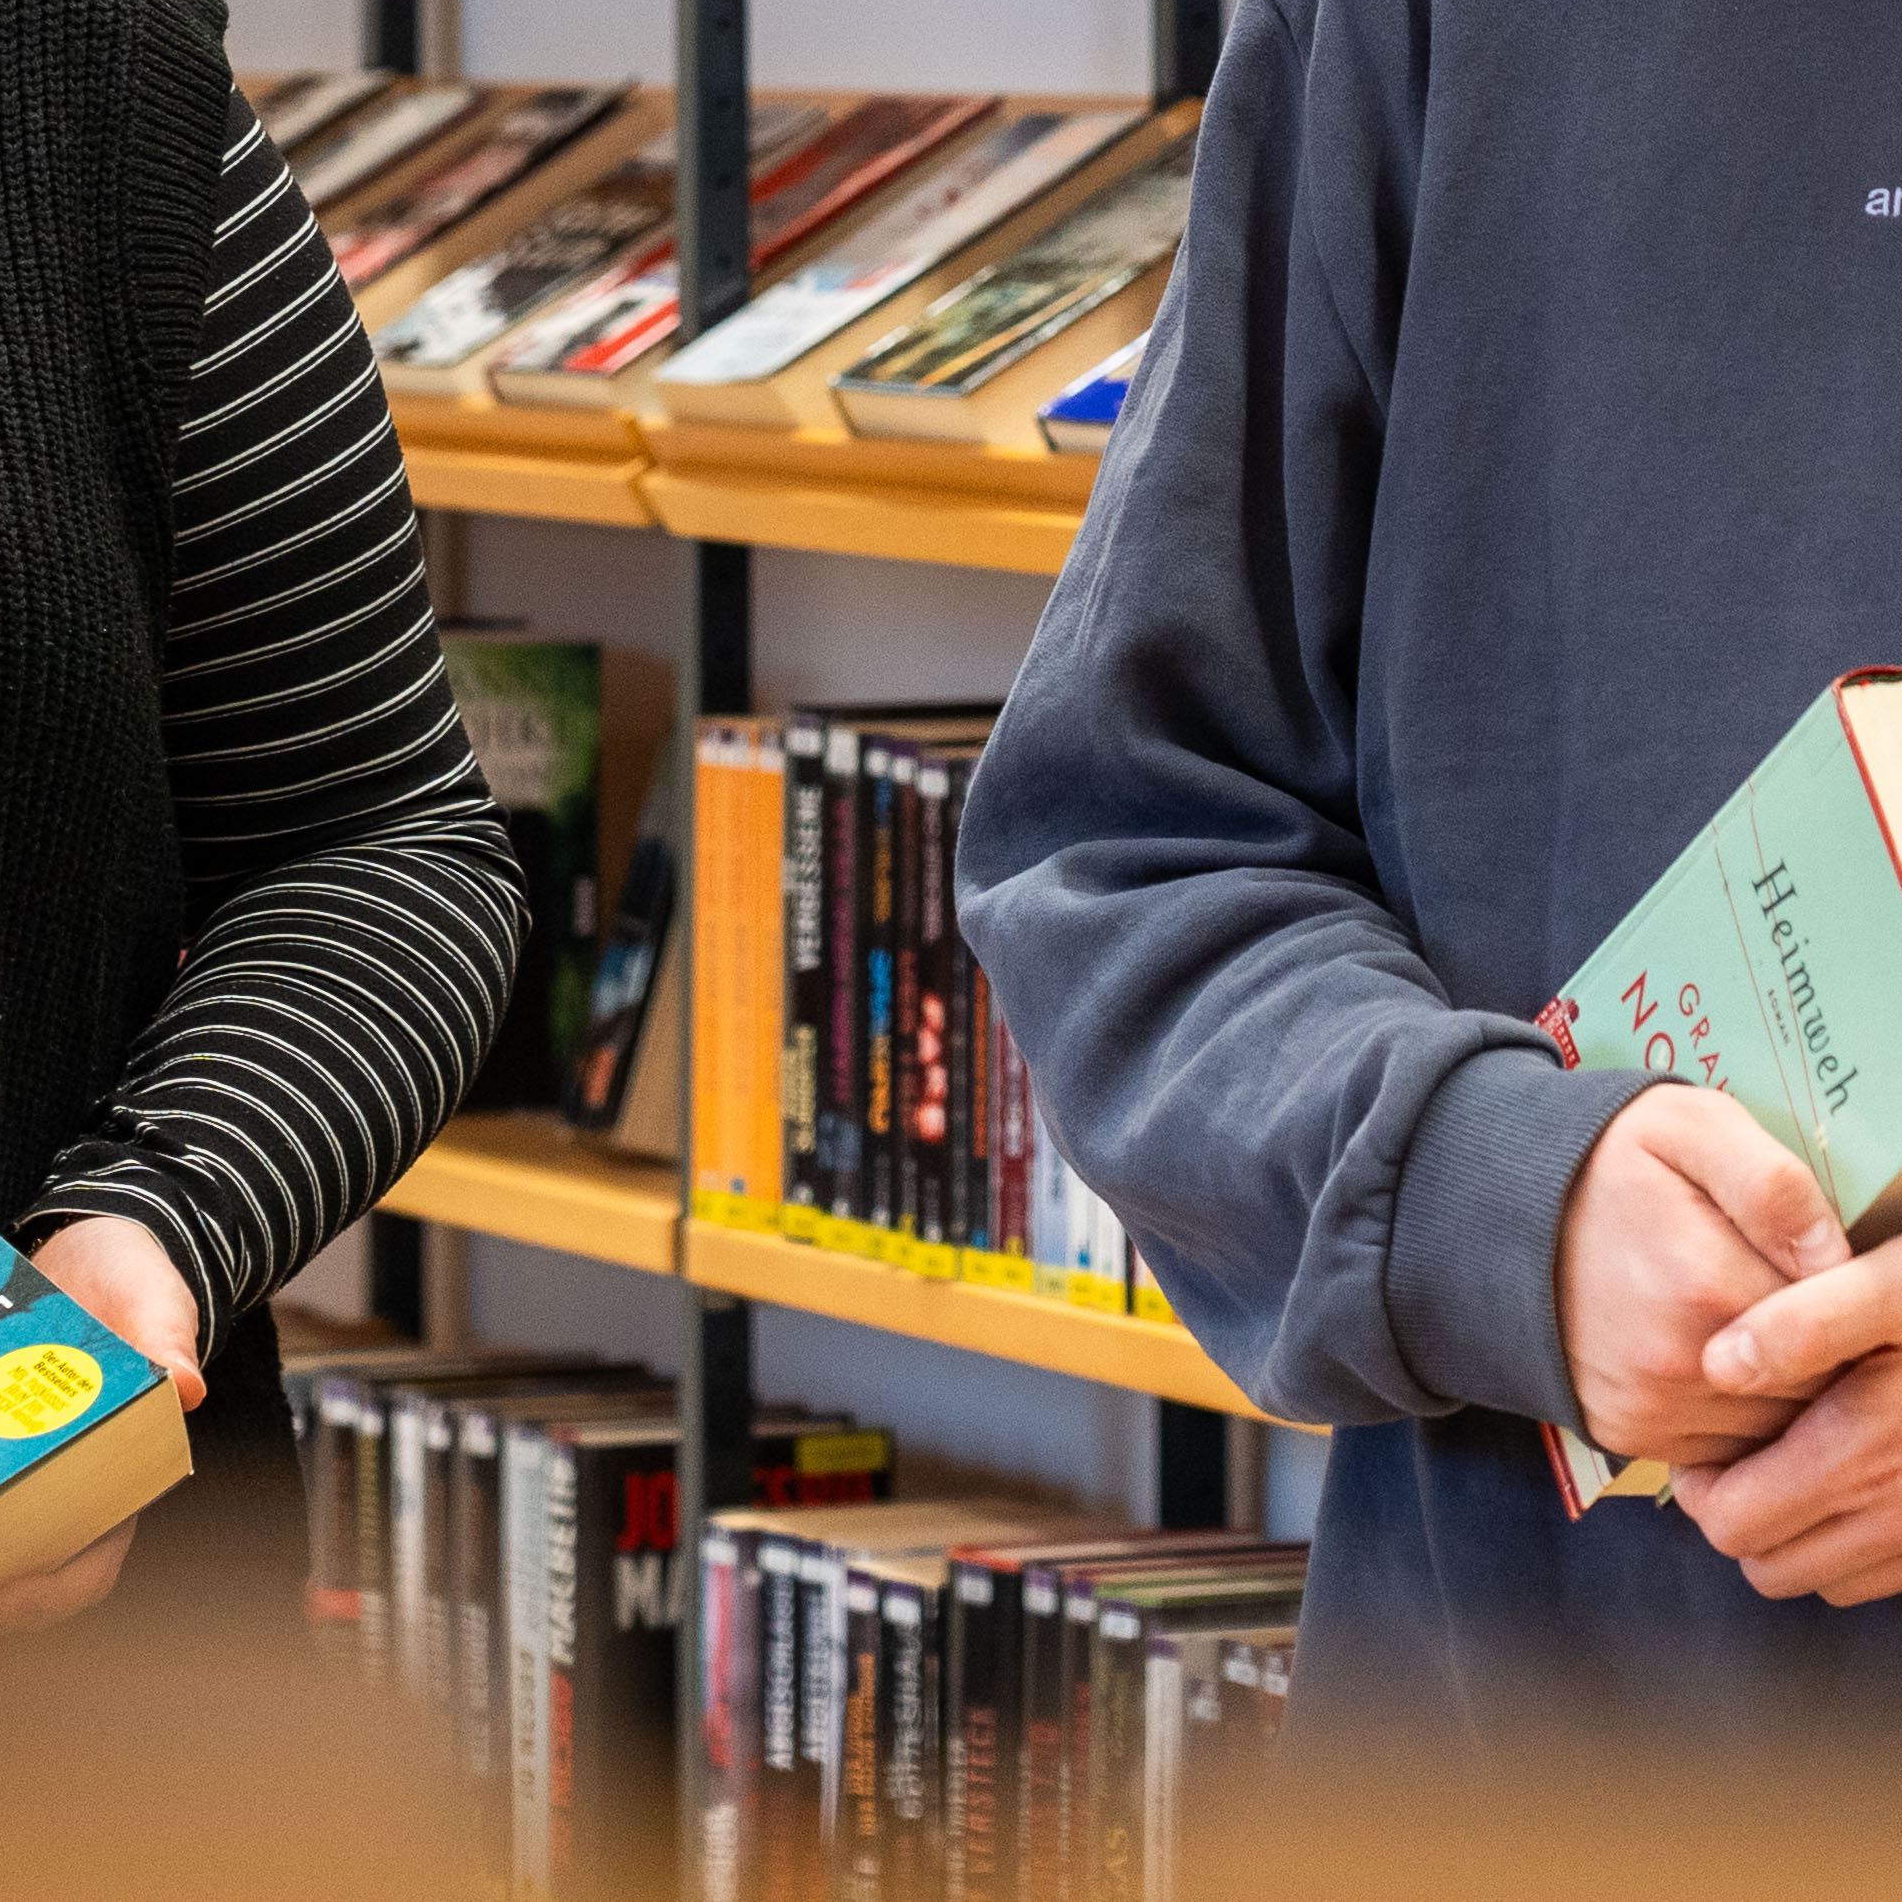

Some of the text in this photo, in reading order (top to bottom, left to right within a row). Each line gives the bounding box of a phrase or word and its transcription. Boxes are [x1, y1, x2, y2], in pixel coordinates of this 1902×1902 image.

[1621, 970, 1676, 1074] NO
[1752, 859, 1859, 1116] Heimweh
[1679, 982, 1736, 1098] GRA
[33, 1361, 79, 1398] Bestsellers
[42, 1350, 94, 1393] Der Autor des
